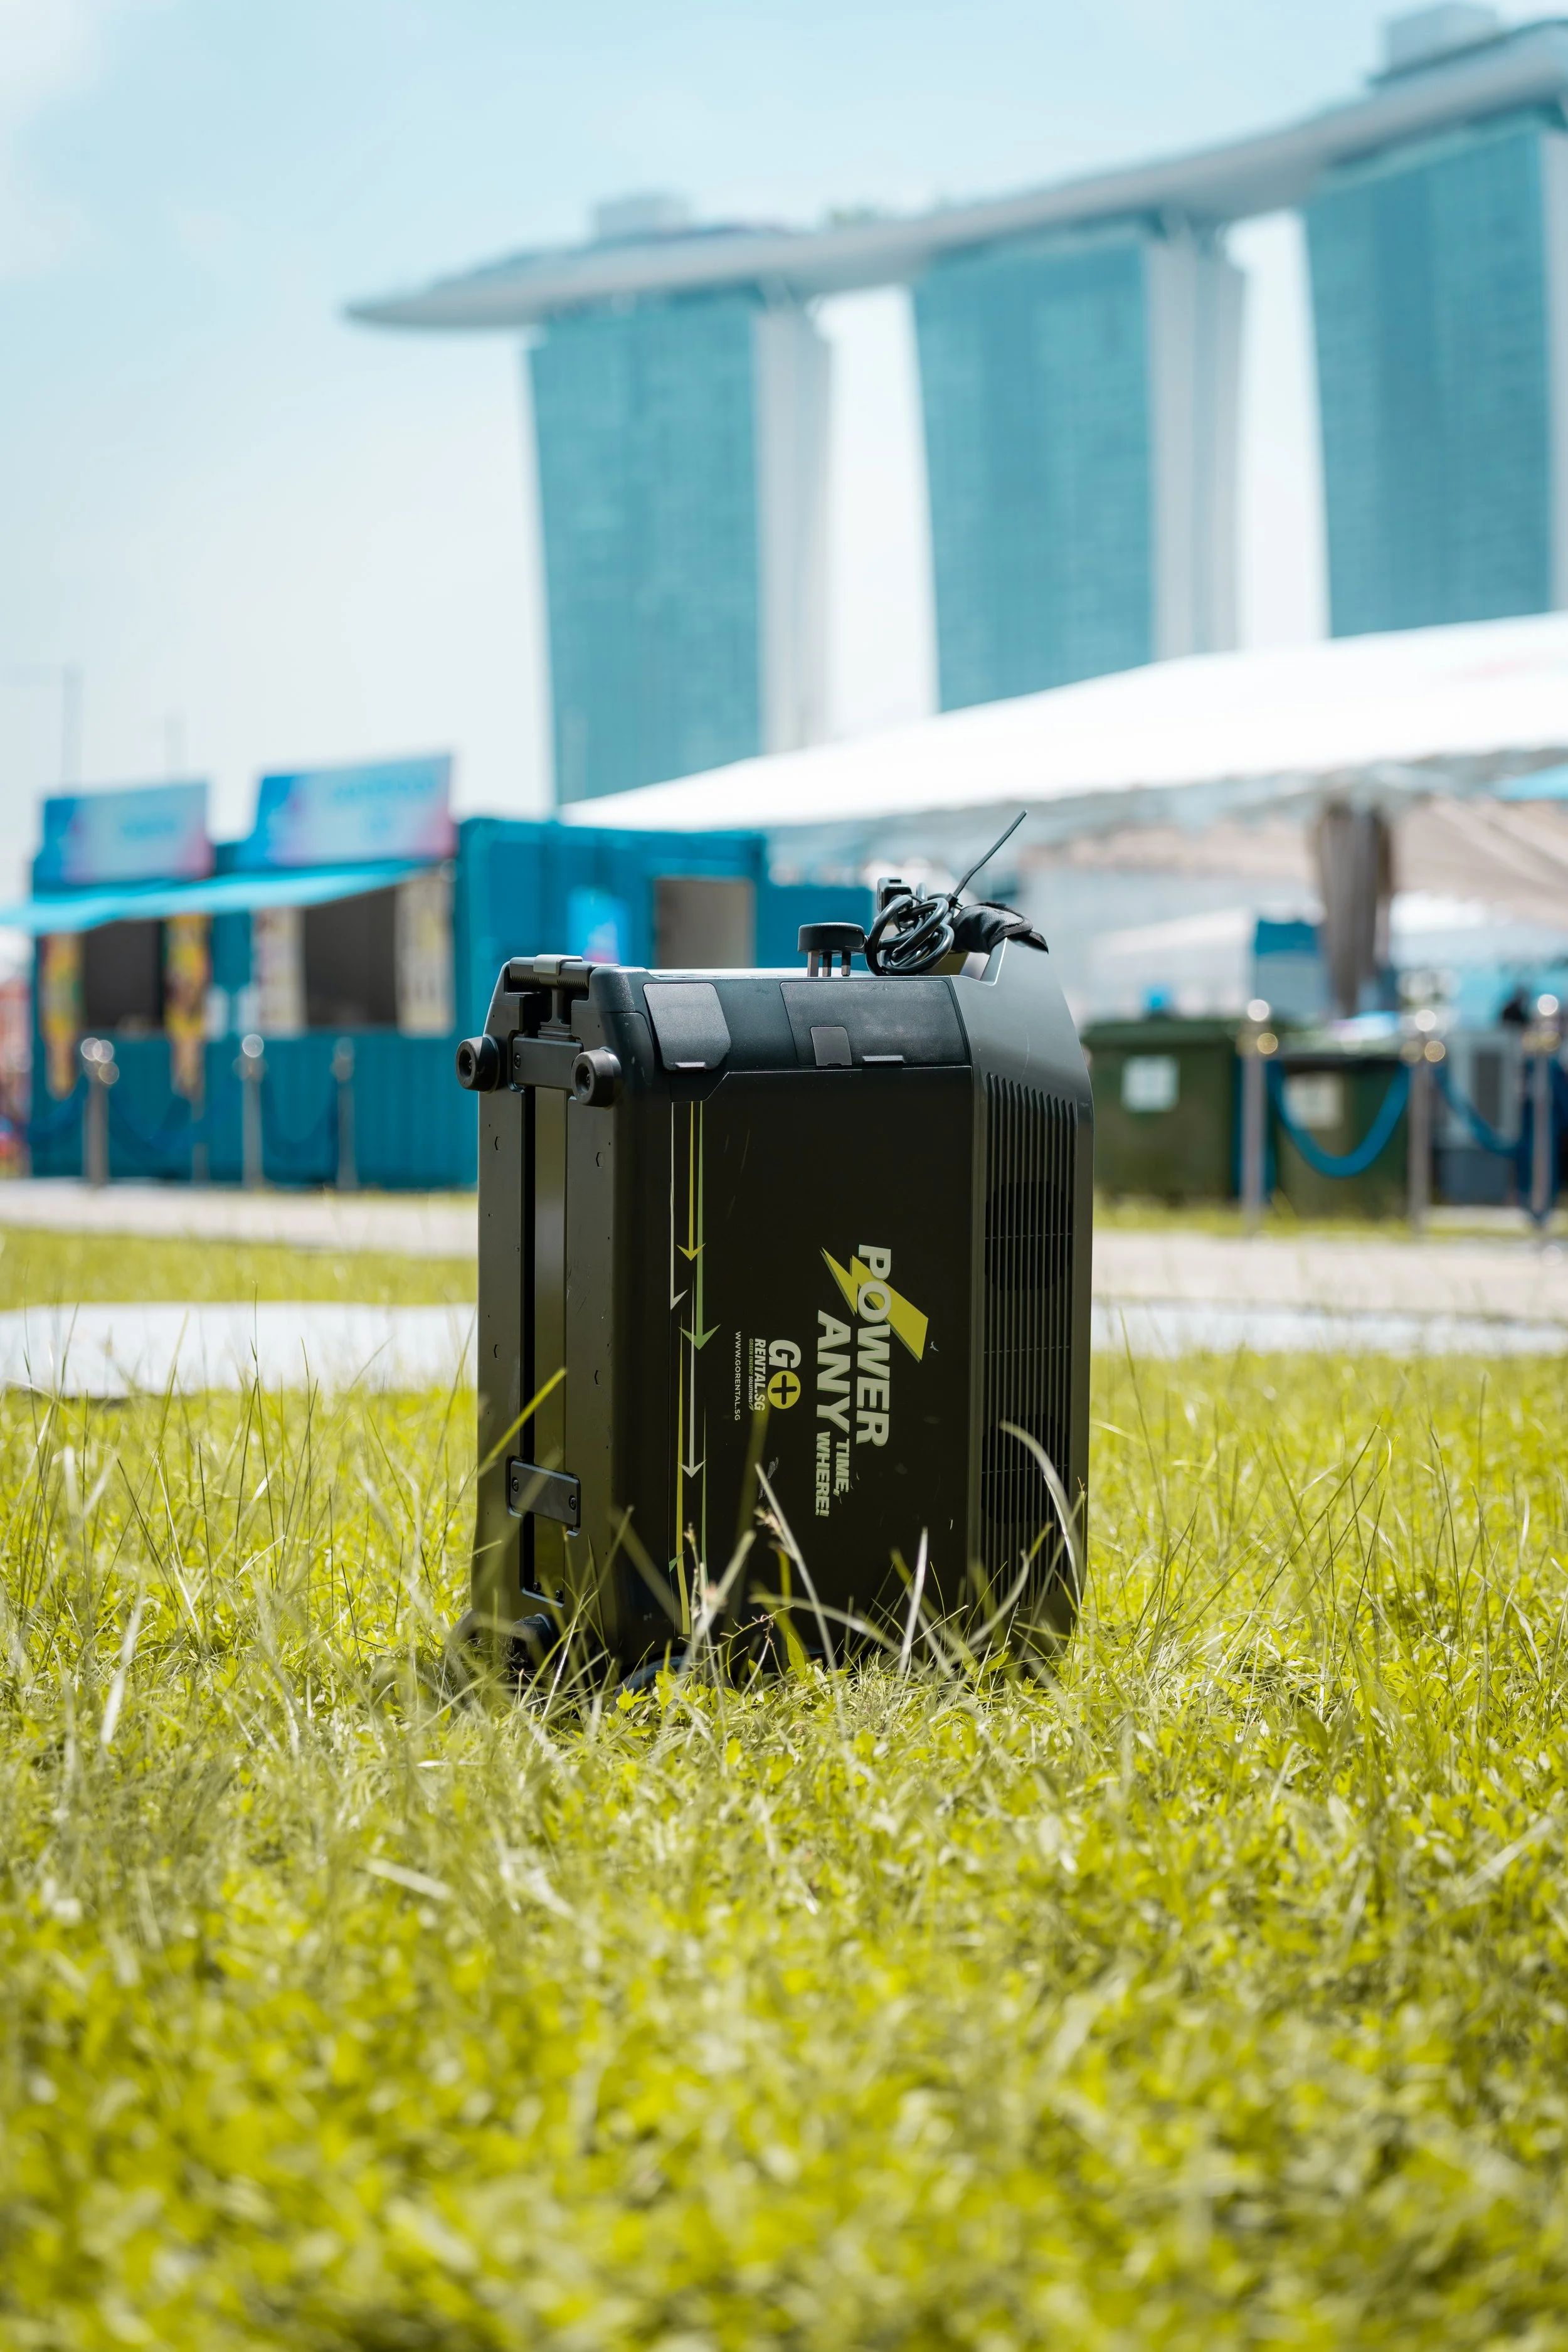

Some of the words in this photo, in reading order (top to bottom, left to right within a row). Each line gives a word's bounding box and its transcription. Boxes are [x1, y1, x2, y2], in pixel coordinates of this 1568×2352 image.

[754, 1338, 766, 1411] RENTAL.SG
[817, 1310, 851, 1434] ANY
[857, 1244, 892, 1447] POWER
[815, 1431, 830, 1517] WHERE!
[833, 1438, 850, 1496] TIME,
